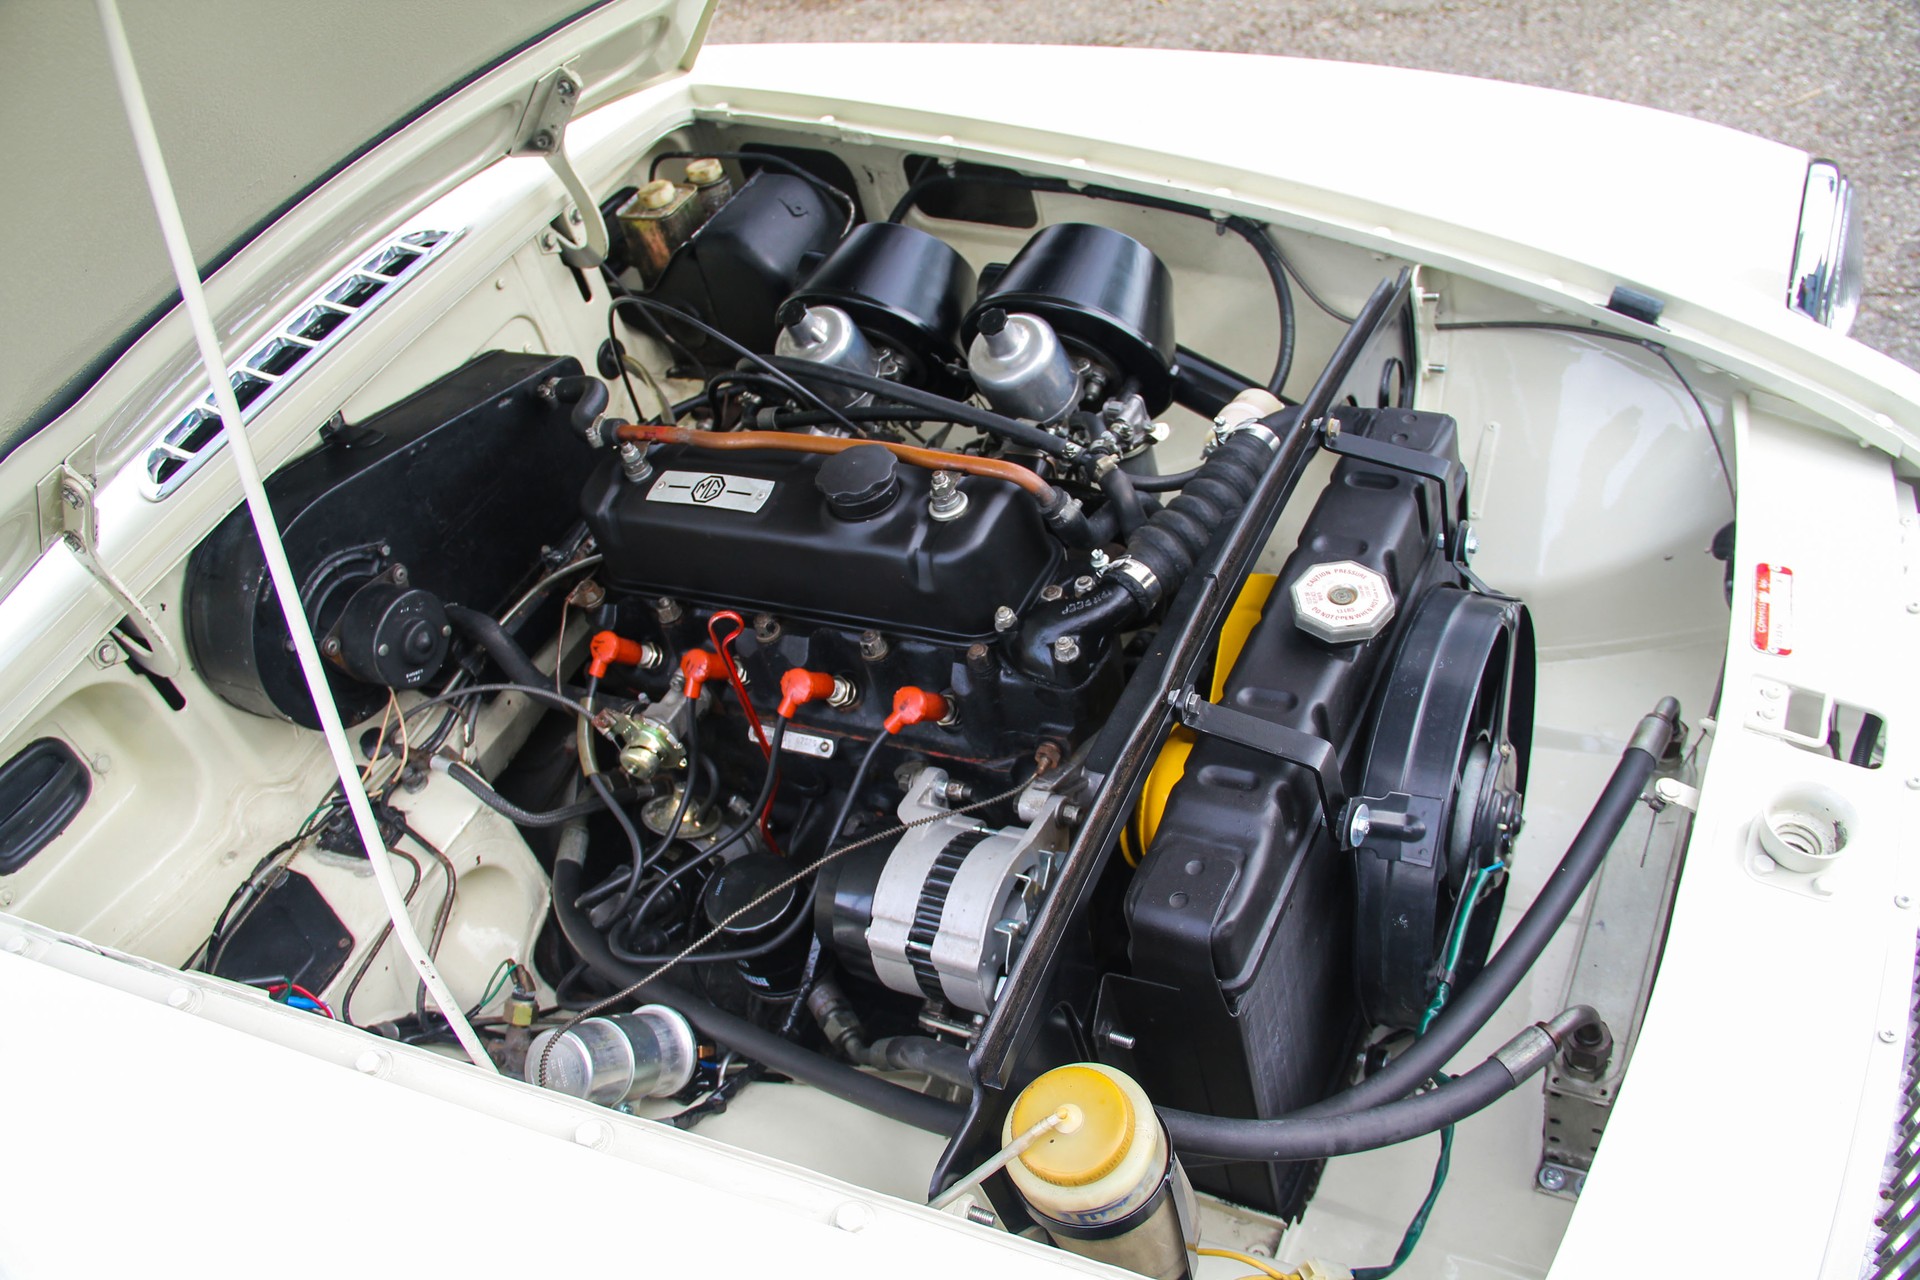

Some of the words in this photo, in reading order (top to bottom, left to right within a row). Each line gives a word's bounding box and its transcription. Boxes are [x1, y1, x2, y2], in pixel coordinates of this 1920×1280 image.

[1307, 569, 1332, 587] CAUTION
[1334, 568, 1368, 580] PRESSURE
[1311, 606, 1322, 614] DO
[1322, 611, 1334, 620] NOT
[1354, 607, 1372, 619] WHEN
